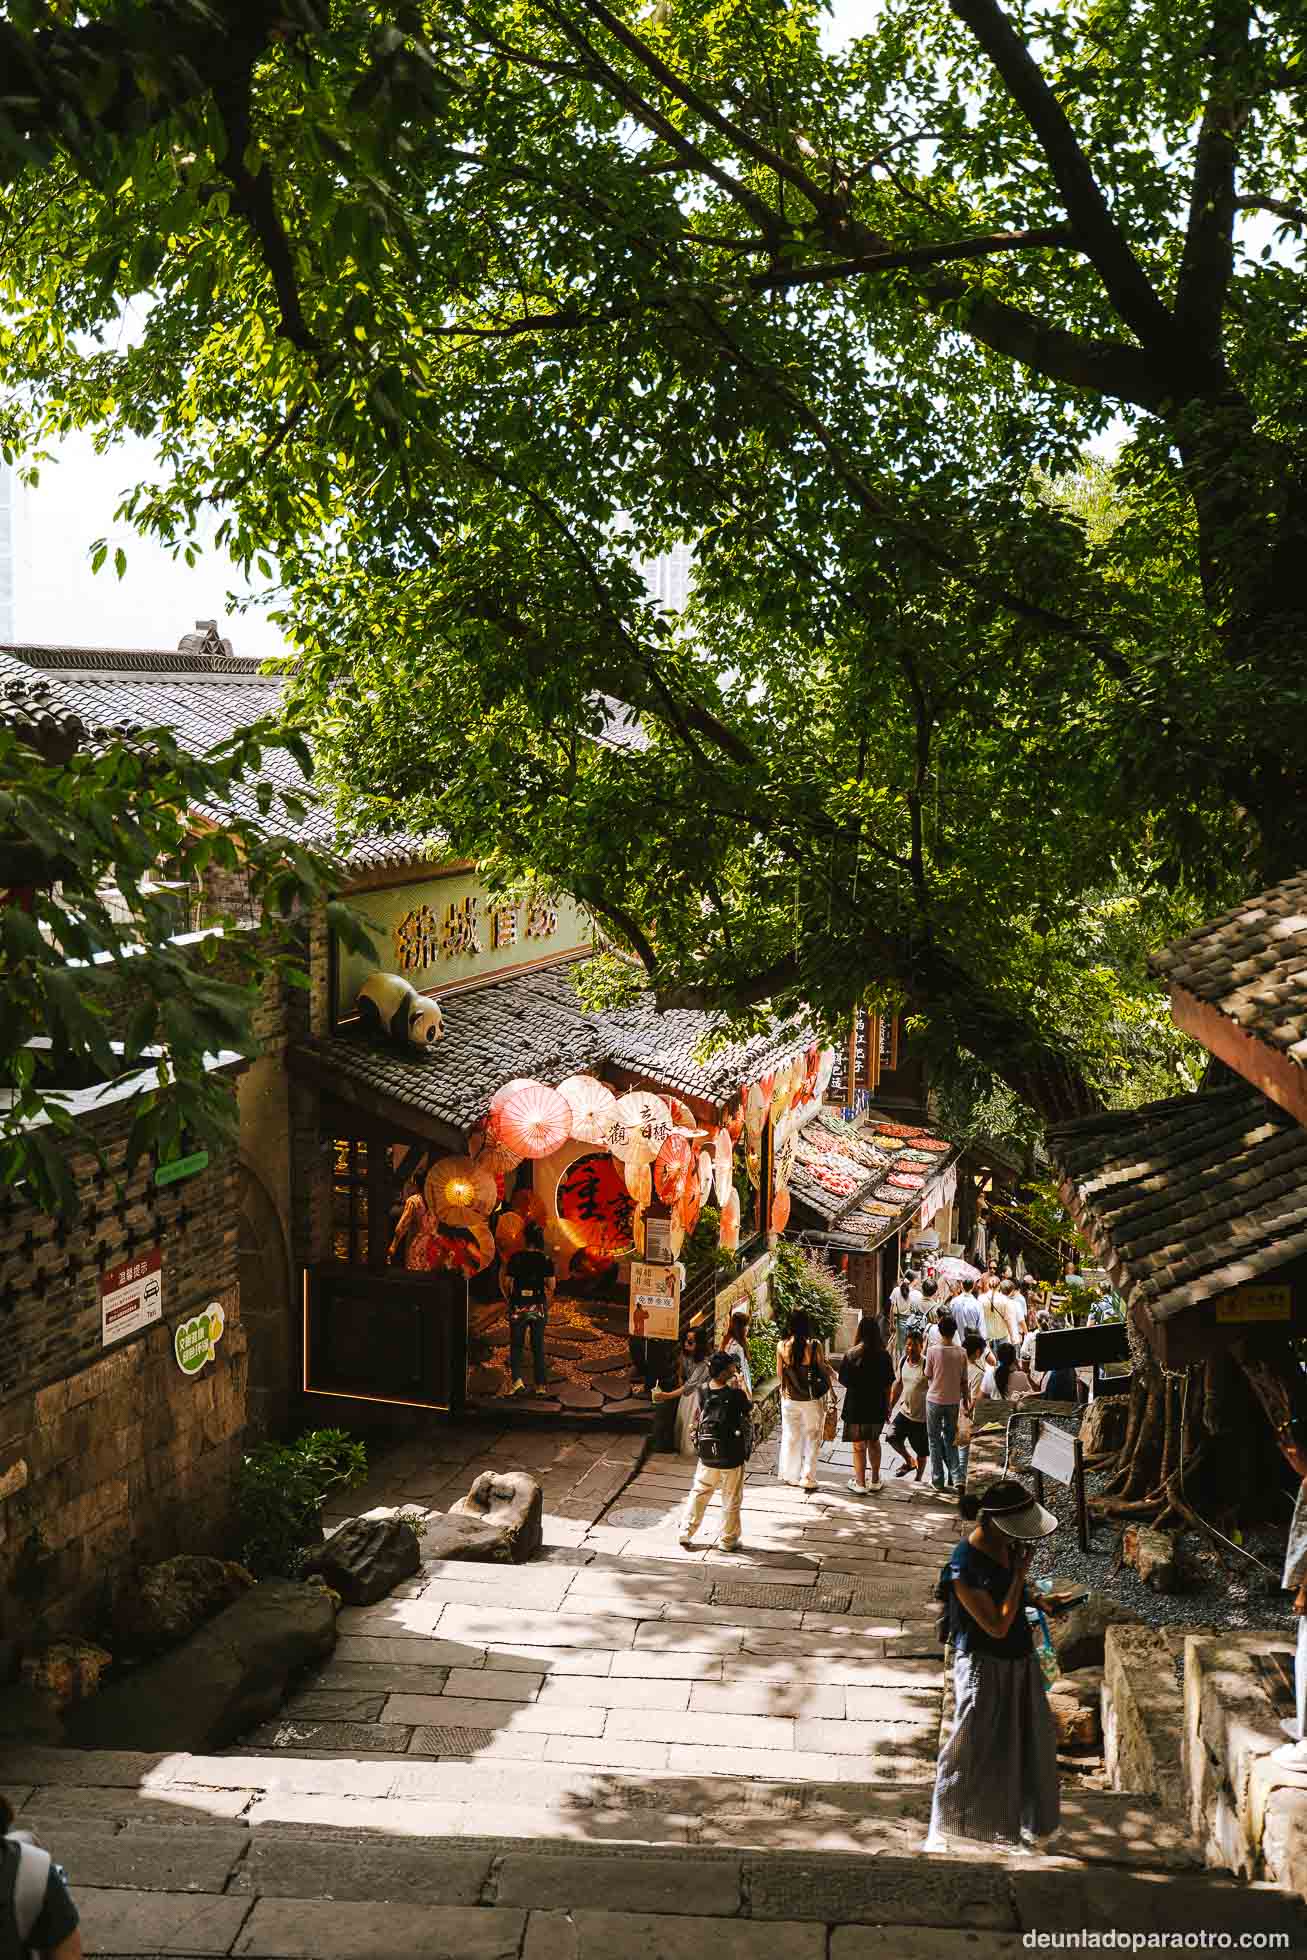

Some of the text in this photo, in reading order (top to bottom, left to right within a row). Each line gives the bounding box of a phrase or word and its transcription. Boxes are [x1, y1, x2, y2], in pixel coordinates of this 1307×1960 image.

[118, 1261, 149, 1285] 温馨提示
[637, 1295, 673, 1307] 免费参观
